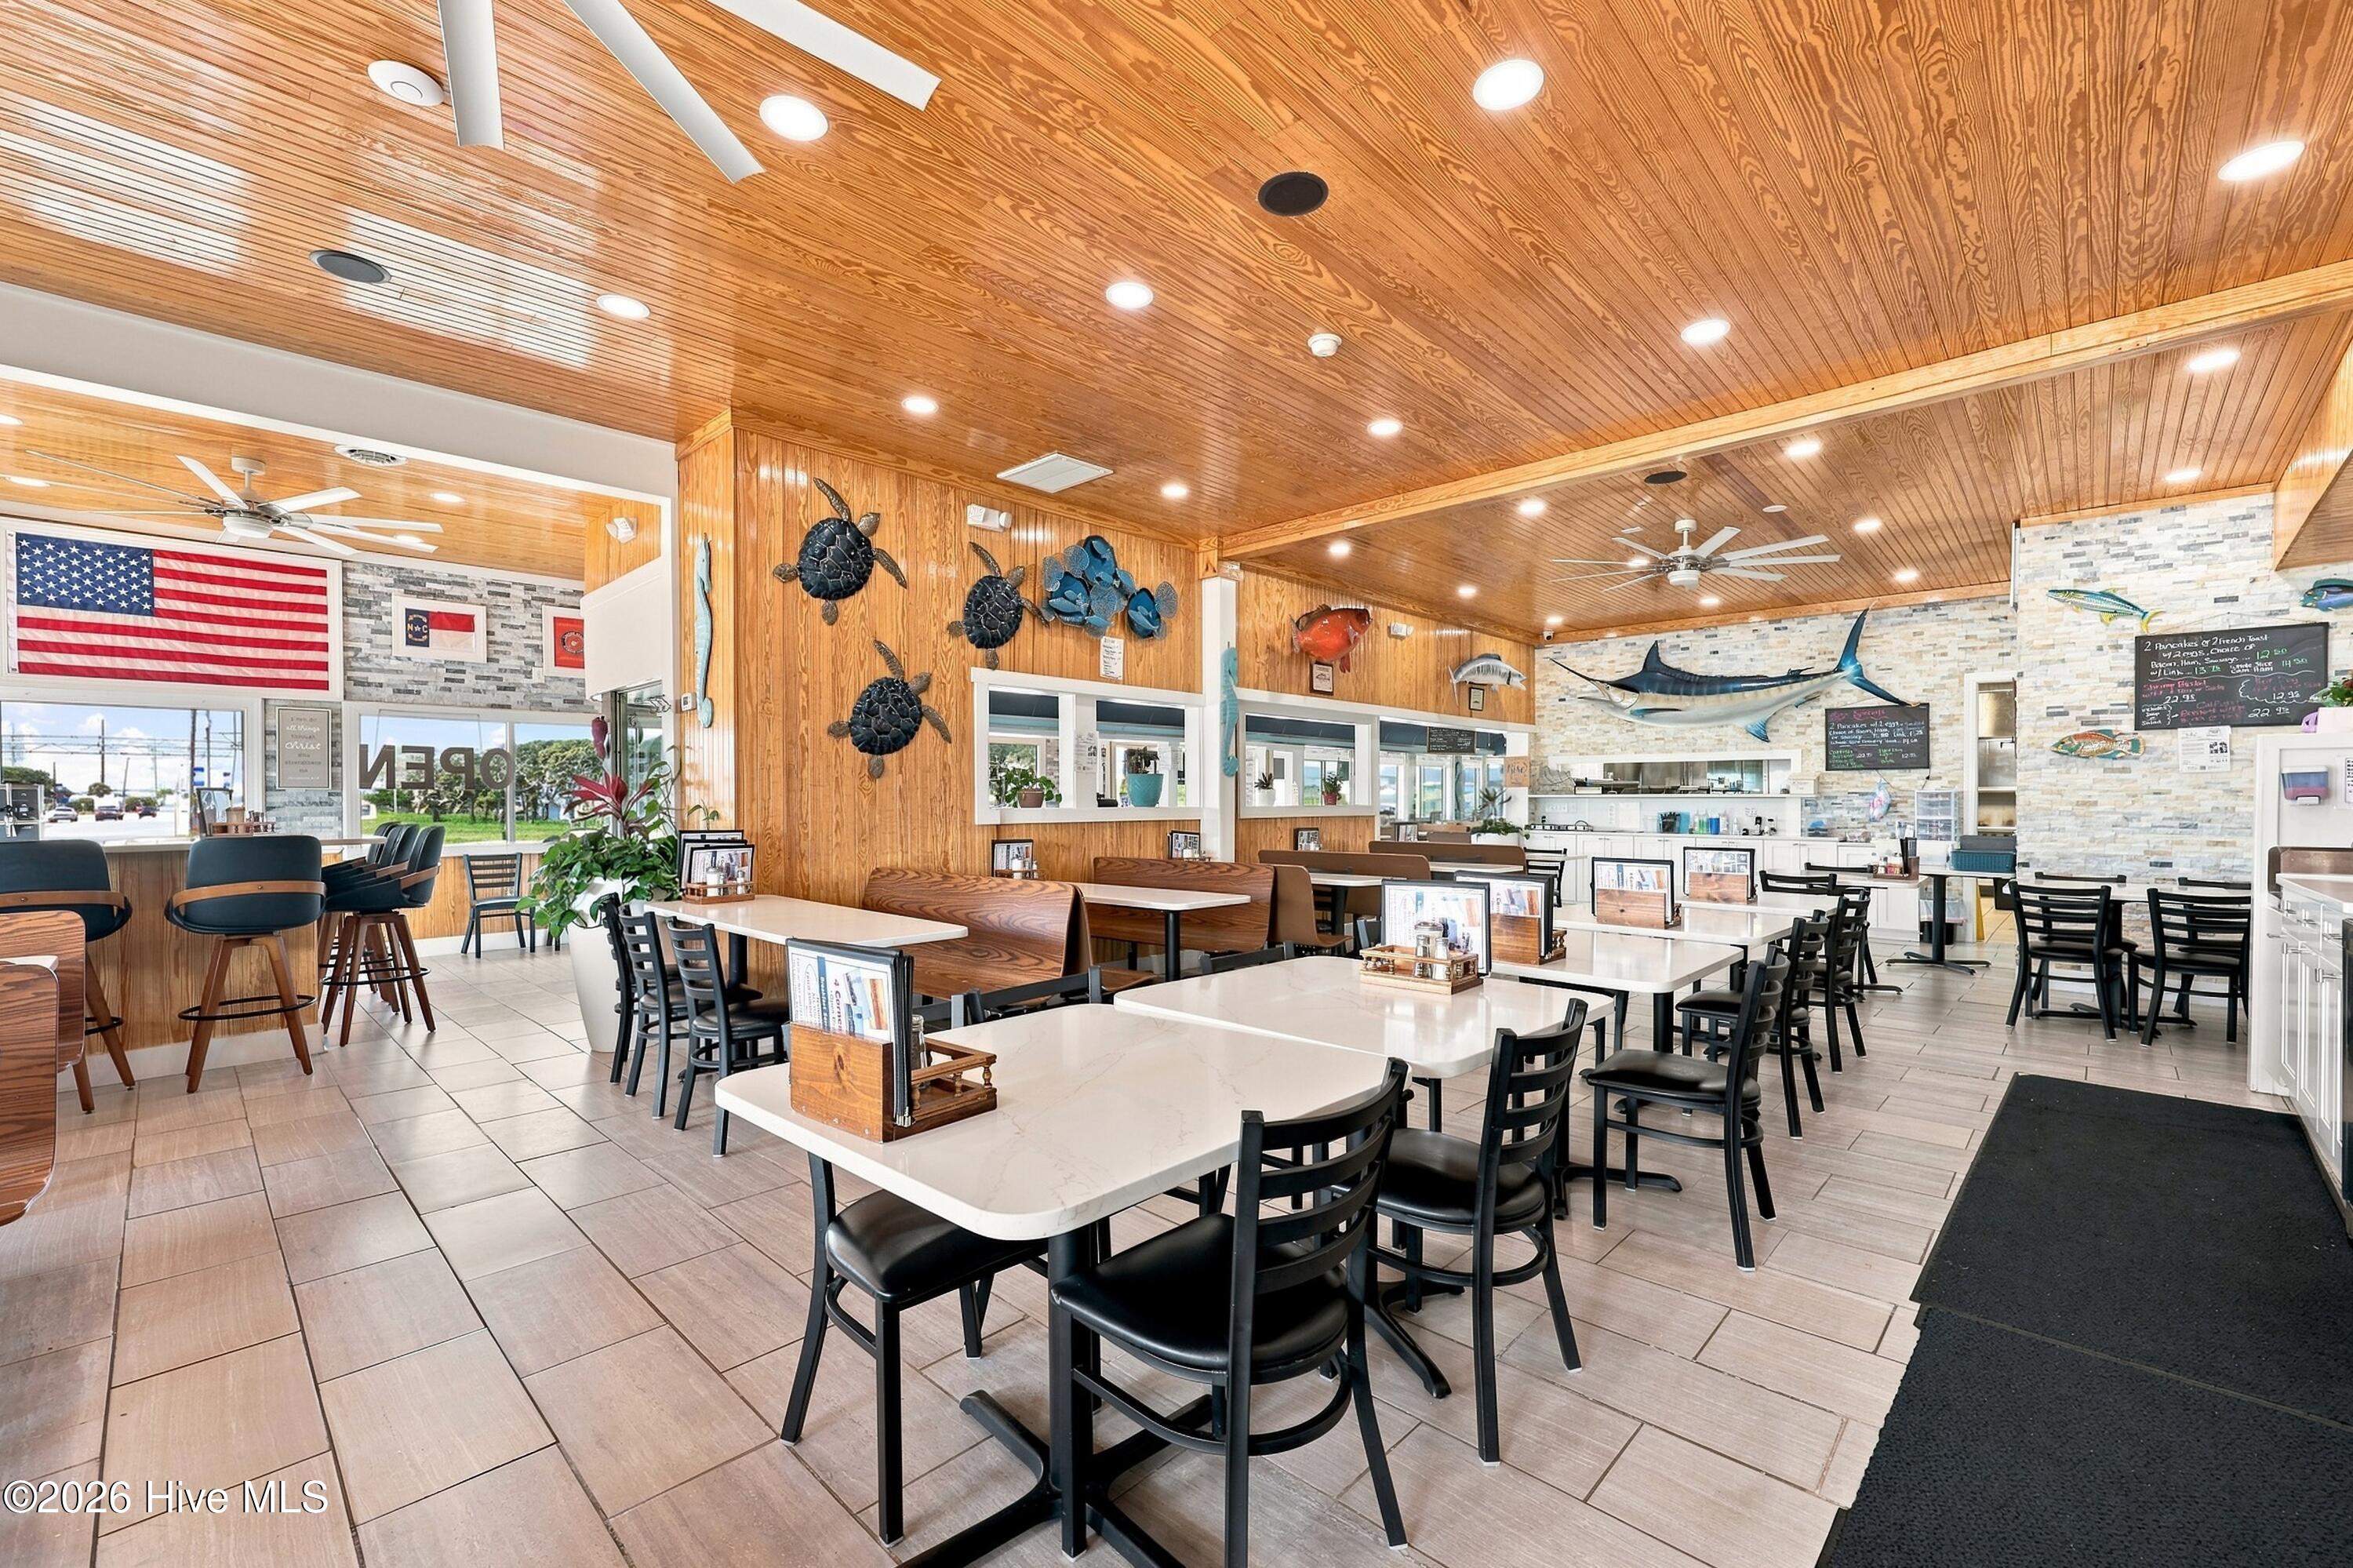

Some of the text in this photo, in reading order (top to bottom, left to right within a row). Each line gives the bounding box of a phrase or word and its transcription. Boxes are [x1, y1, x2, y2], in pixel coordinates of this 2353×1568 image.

[422, 624, 428, 633] C
[2144, 641, 2151, 651] 2
[2155, 639, 2198, 650] Pancakes
[2210, 646, 2240, 654] Choice
[285, 741, 321, 750] Christ
